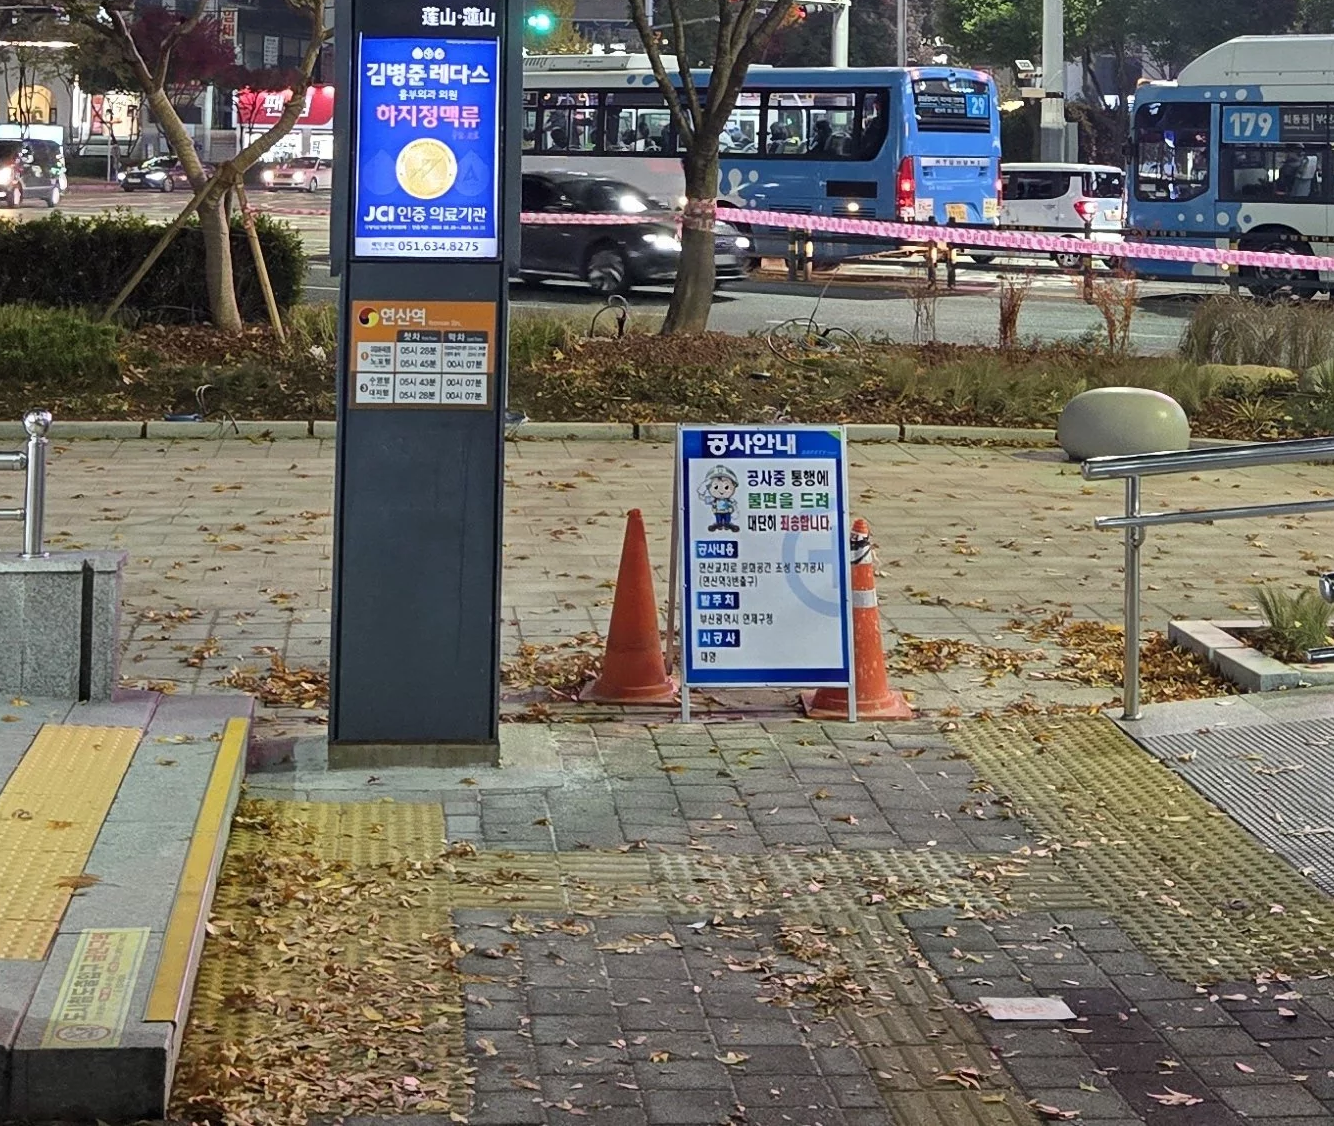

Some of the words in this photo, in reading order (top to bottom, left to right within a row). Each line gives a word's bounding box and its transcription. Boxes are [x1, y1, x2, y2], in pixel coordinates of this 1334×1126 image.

[367, 63, 427, 87] 김병준
[430, 62, 490, 85] 레다스
[971, 96, 985, 115] 29
[376, 104, 481, 128] 하지정맥류
[1229, 112, 1273, 137] 179
[364, 205, 394, 222] JCI
[397, 206, 426, 223] 인증
[430, 206, 487, 223] 의료기관
[398, 241, 479, 252] 051.634.8275
[380, 308, 426, 326] 연산역
[403, 332, 420, 341] 첫차
[448, 333, 465, 341] 막차
[400, 346, 417, 355] 05시
[400, 360, 417, 368] 05시
[447, 360, 464, 369] 00시
[467, 360, 482, 369] 07분
[399, 378, 417, 386] 05시
[446, 378, 463, 387] 00시
[465, 378, 482, 387] 07분
[399, 391, 416, 400] 05시
[446, 392, 462, 400] 00시
[465, 392, 482, 400] 07분
[707, 434, 796, 456] 공사안내
[747, 470, 786, 487] 공사중
[791, 470, 829, 487] 통행에
[748, 492, 793, 510] 불편을
[800, 492, 830, 510] 드려
[747, 515, 777, 532] 대단히
[780, 515, 833, 532] 죄송합니다.
[697, 542, 735, 556] 공사내용
[699, 562, 738, 574] 연산교차로
[741, 562, 772, 574] 문화공간
[775, 562, 791, 574] 조성
[794, 562, 824, 574] 전기공사
[699, 575, 758, 588] (연산역3번출구)
[700, 594, 735, 607] 발주처
[699, 613, 739, 625] 부산광역시
[742, 613, 774, 625] 연제구청
[701, 631, 736, 645] 시공사
